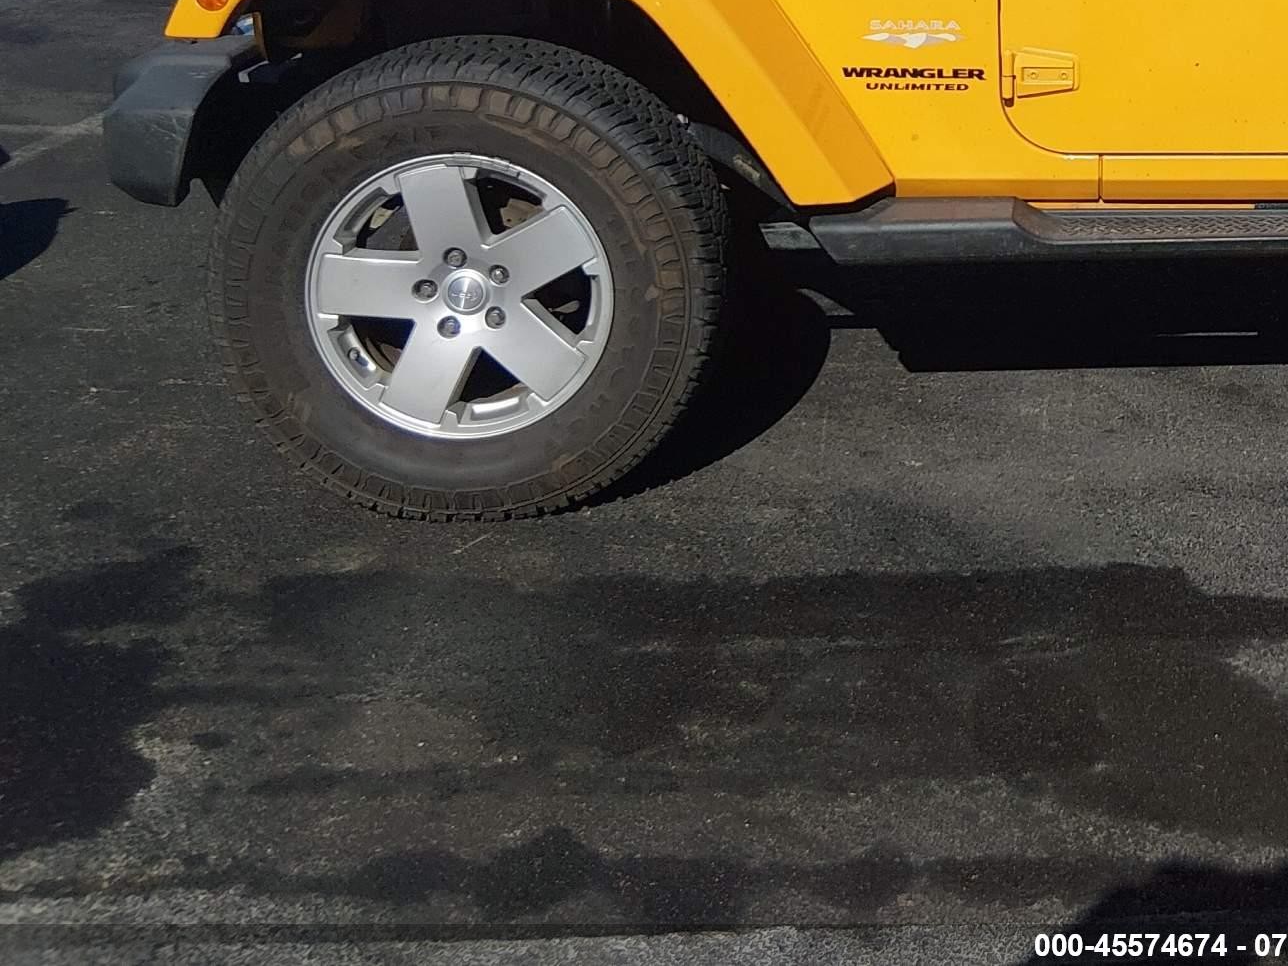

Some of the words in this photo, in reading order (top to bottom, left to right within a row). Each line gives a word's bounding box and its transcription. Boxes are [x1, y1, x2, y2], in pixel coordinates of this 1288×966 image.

[869, 19, 961, 30] SAHARA
[842, 67, 986, 80] WRANGLER
[865, 83, 969, 91] UNLIMITED
